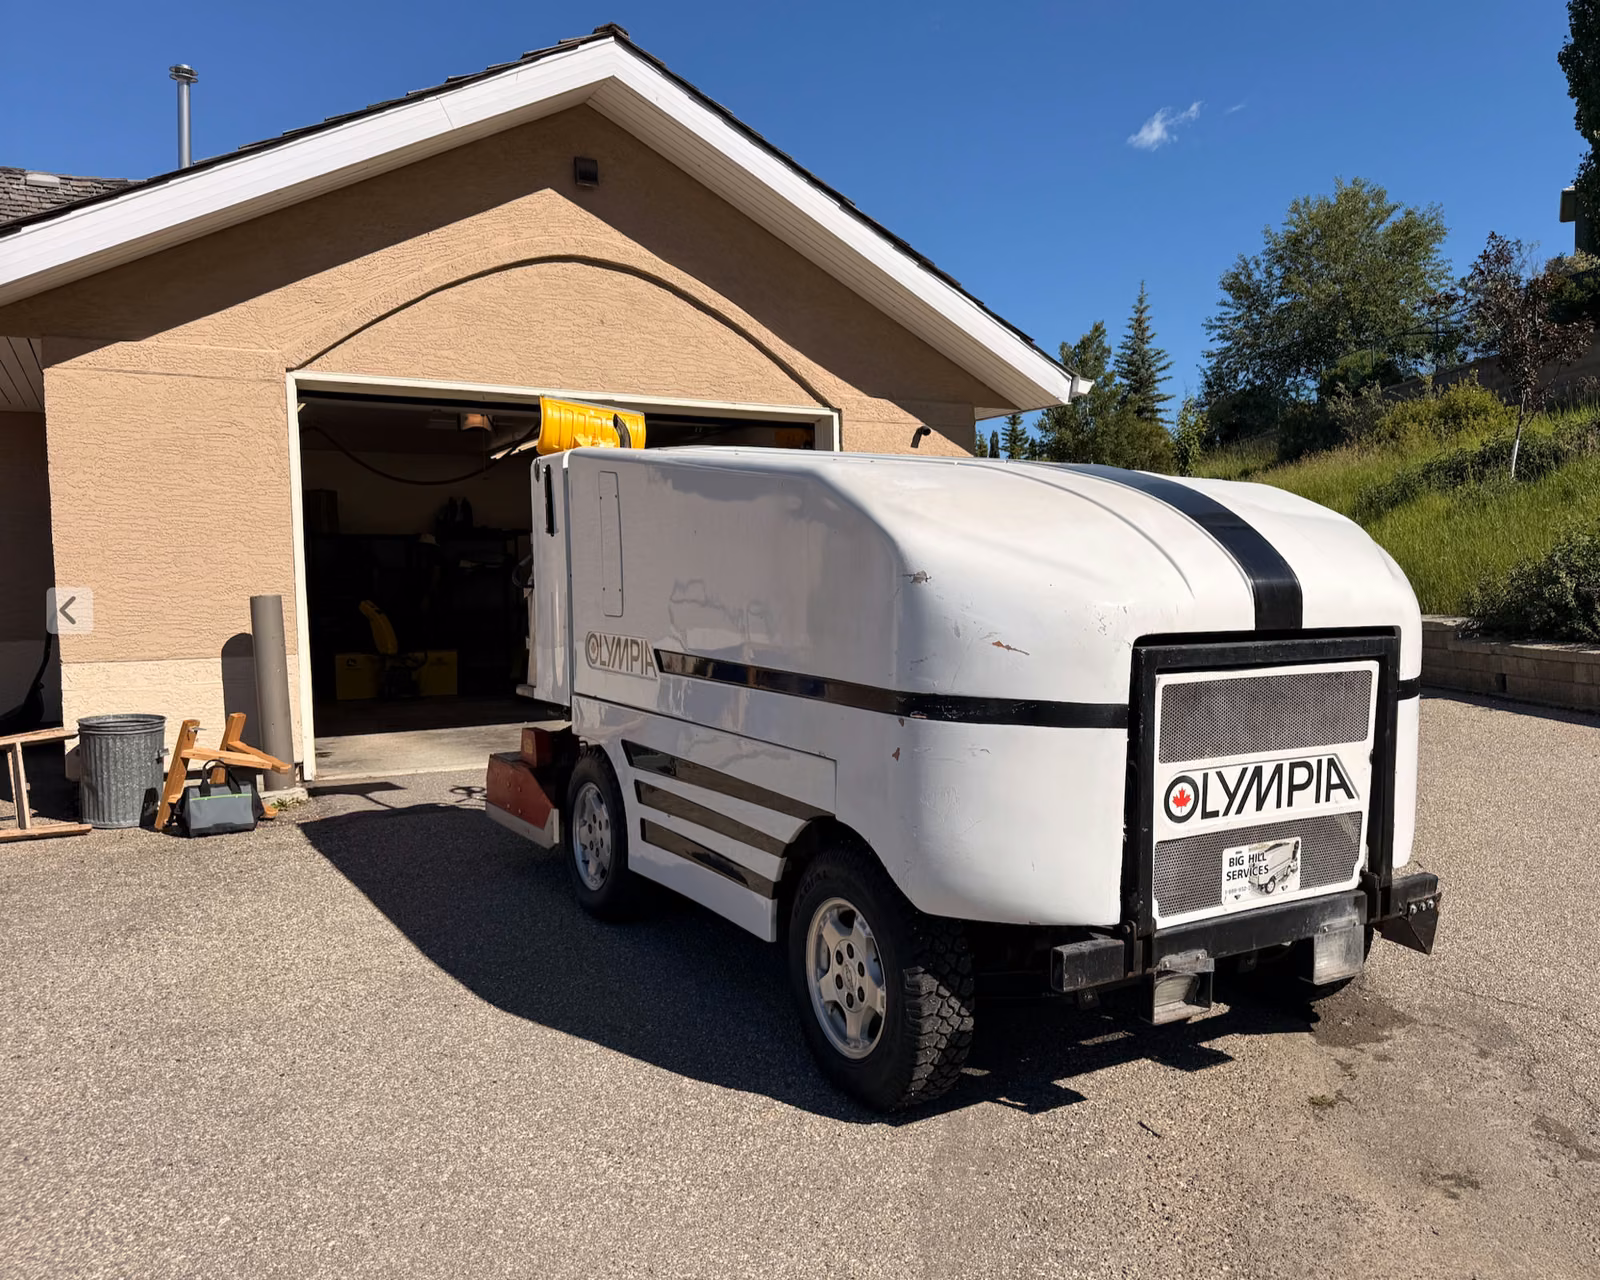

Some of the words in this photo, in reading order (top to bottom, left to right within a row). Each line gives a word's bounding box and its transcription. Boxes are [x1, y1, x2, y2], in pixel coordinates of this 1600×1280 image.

[587, 633, 657, 678] OLYMPIA
[1164, 757, 1355, 824] OLYMPIA
[1226, 864, 1269, 882] SERVICES
[1228, 855, 1245, 868] BIG
[1248, 852, 1267, 864] HILL
